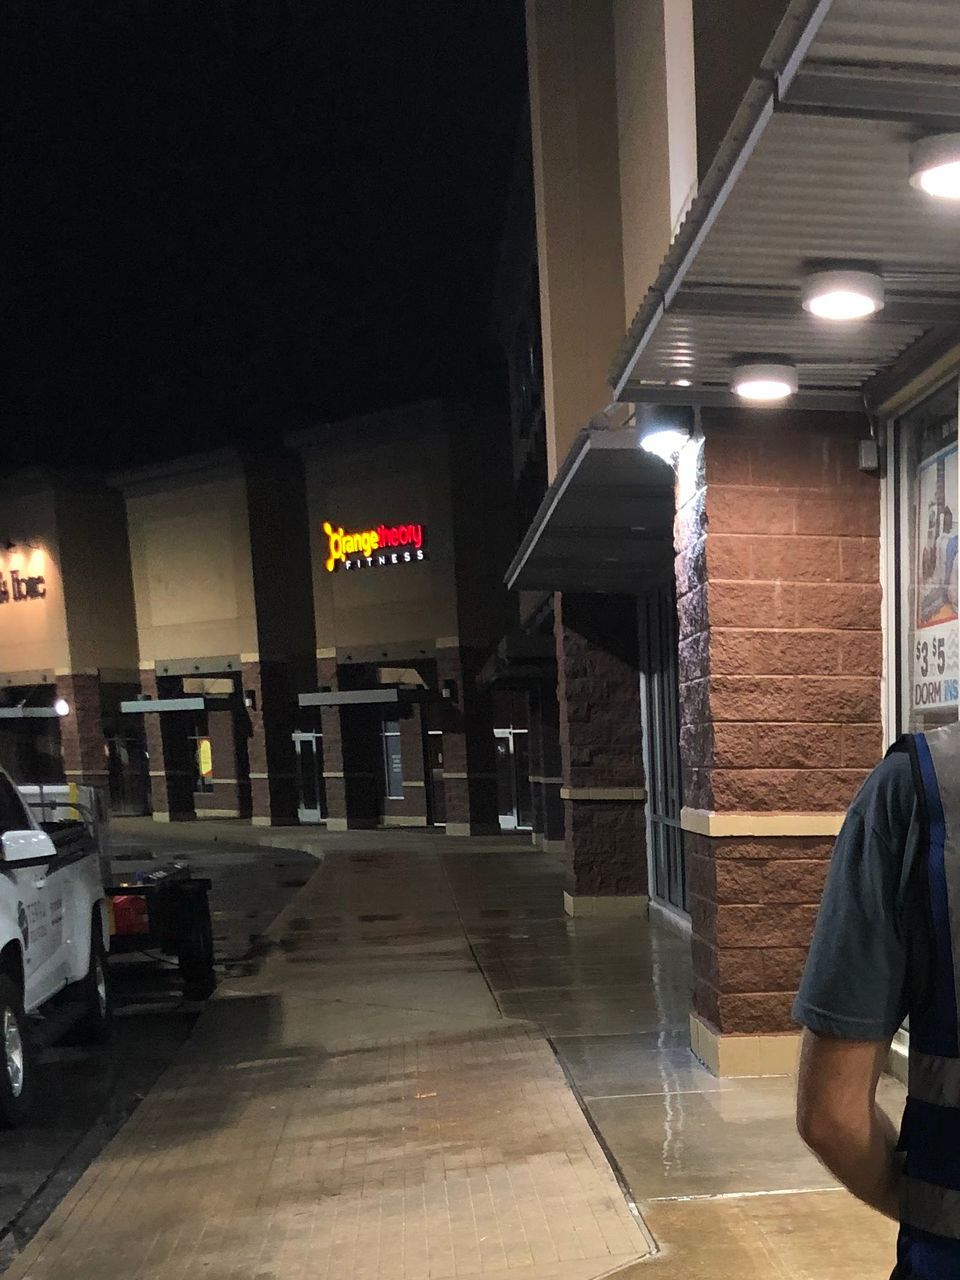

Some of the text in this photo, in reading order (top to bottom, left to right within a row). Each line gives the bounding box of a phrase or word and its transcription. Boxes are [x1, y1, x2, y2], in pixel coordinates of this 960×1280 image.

[345, 550, 424, 570] FITNESS
[916, 636, 945, 677] $3 $5
[915, 680, 941, 705] DORM
